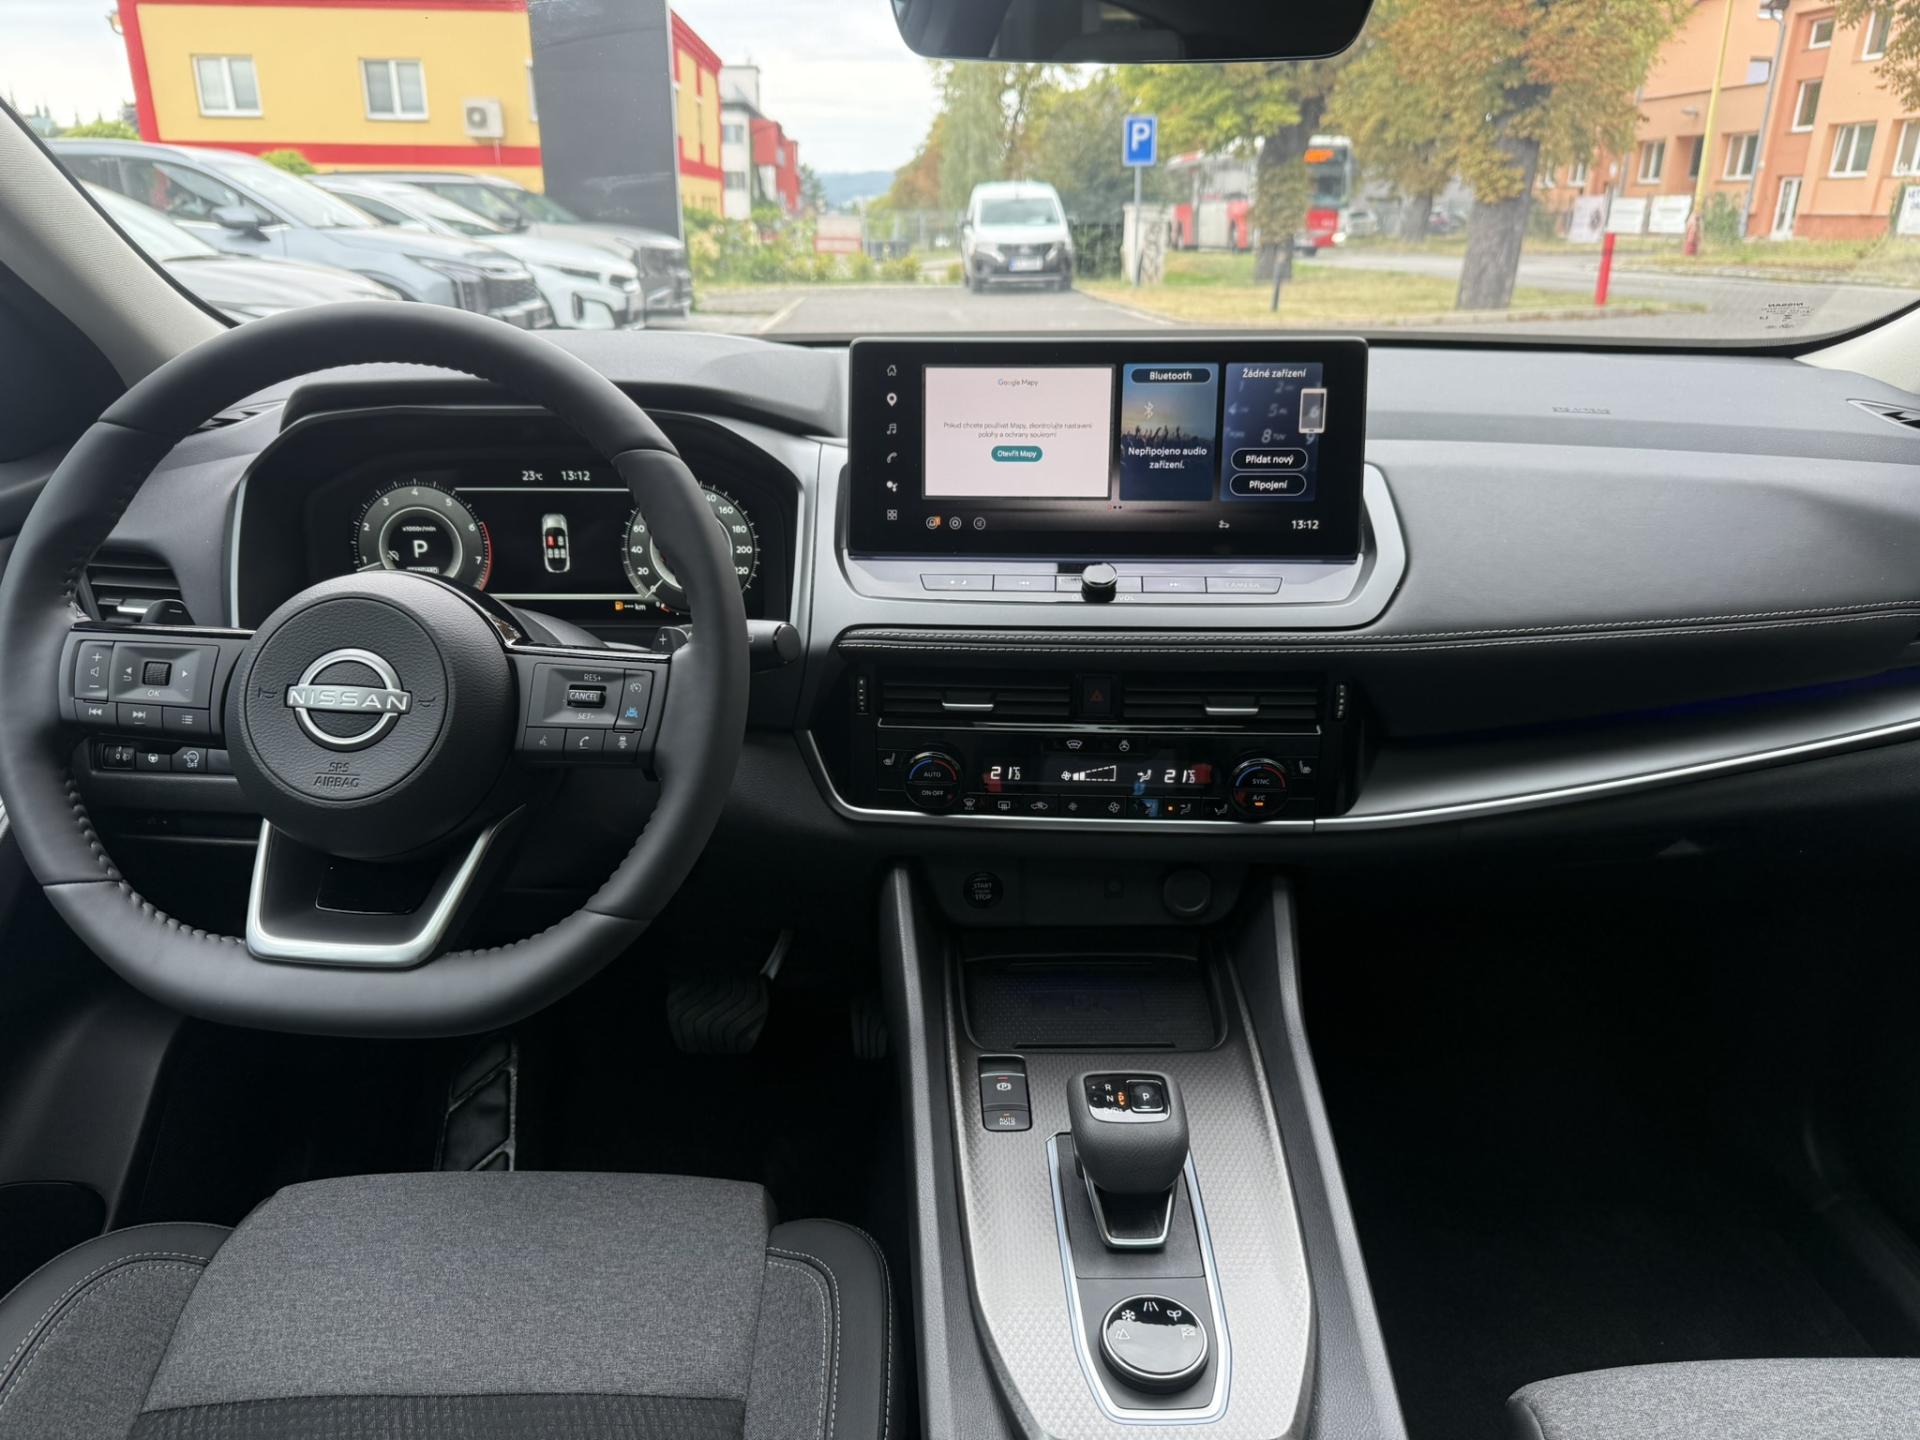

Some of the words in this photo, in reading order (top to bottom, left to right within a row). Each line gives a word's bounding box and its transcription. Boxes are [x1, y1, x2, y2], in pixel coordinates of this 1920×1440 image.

[1131, 122, 1151, 151] P
[1149, 370, 1192, 381] Bluetooth
[1242, 367, 1270, 378] Žádné
[1271, 368, 1306, 379] zařízení
[998, 378, 1020, 388] Google
[1021, 378, 1038, 387] Mapy
[997, 449, 1019, 457] Otevřít
[1020, 450, 1037, 459] Mapy
[1128, 447, 1180, 459] Nepřipojeno
[1182, 447, 1207, 457] audio
[1149, 460, 1185, 470] zařízení.
[1245, 454, 1271, 465] Přidat
[1272, 456, 1294, 466] nový
[561, 471, 591, 481] 13:12
[1249, 479, 1288, 490] Připojení
[411, 486, 419, 496] 4
[382, 497, 390, 506] 3
[445, 497, 453, 507] 5
[718, 506, 734, 514] 160
[363, 522, 371, 532] 2
[468, 523, 476, 532] 6
[633, 525, 645, 533] 60
[1291, 519, 1319, 529] 13:12
[413, 540, 428, 559] P
[631, 546, 643, 554] 40
[736, 545, 753, 554] 200
[362, 555, 368, 564] 1
[475, 556, 482, 565] 7
[637, 567, 649, 576] 20
[147, 689, 160, 697] OK
[569, 691, 598, 701] CANCEL
[289, 690, 408, 711] NISSAN
[328, 762, 350, 773] SRS
[313, 776, 360, 788] AIRBAG
[1104, 1083, 1112, 1091] R
[1142, 1092, 1150, 1101] P
